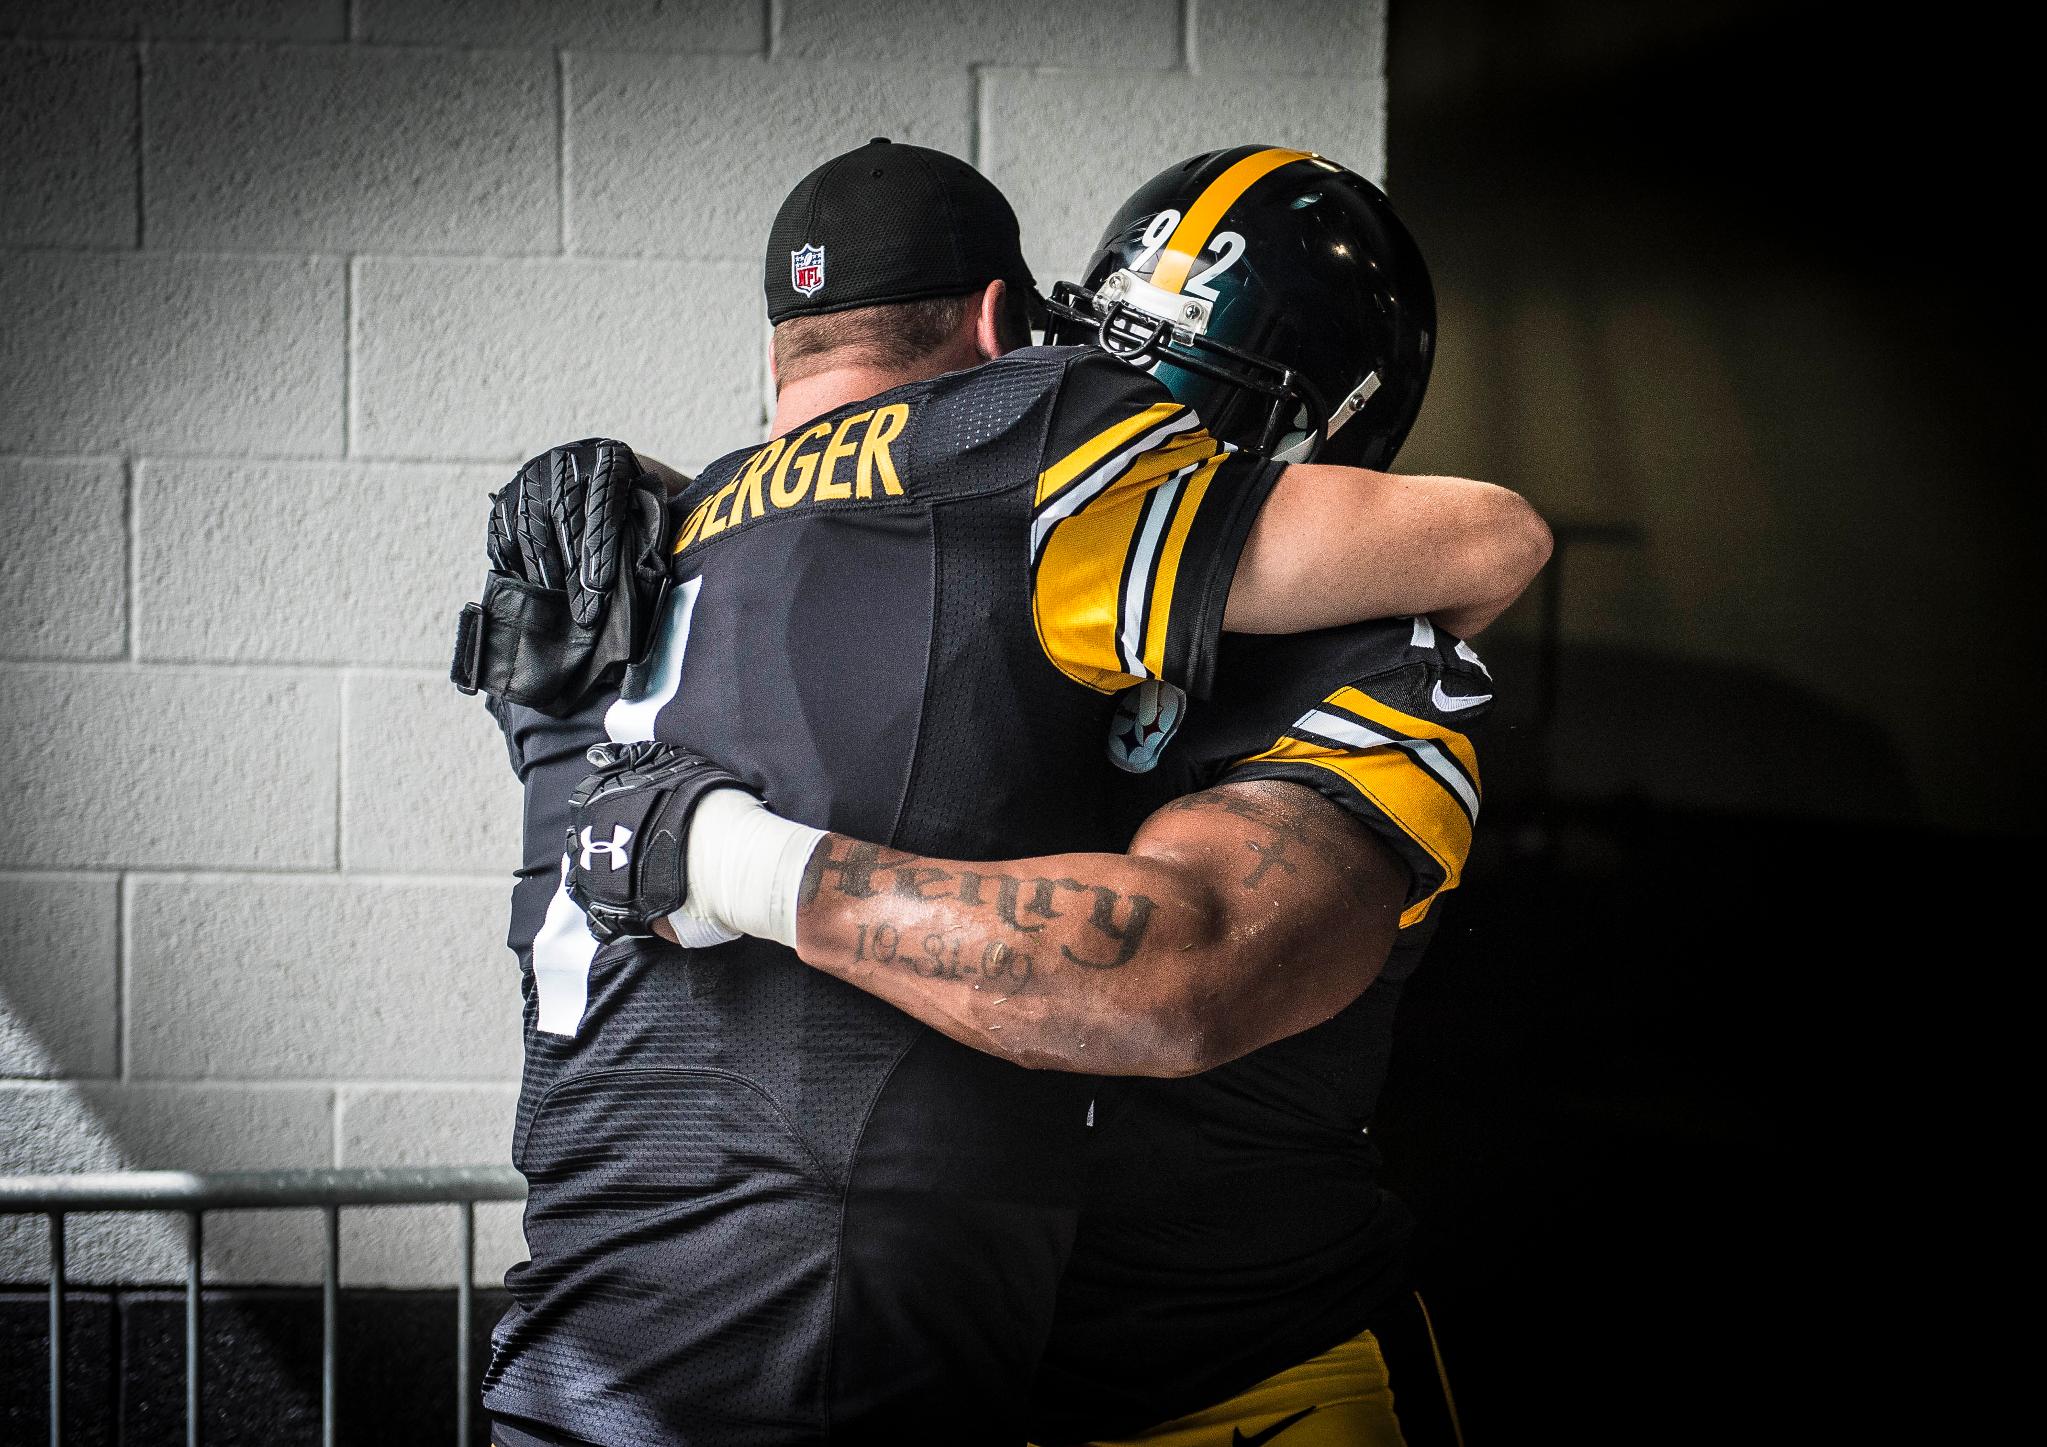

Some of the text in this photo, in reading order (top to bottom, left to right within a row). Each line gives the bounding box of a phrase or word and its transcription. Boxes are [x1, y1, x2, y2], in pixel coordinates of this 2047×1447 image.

[797, 266, 822, 288] NFL
[1128, 208, 1247, 302] 92
[800, 832, 1159, 969] Henry
